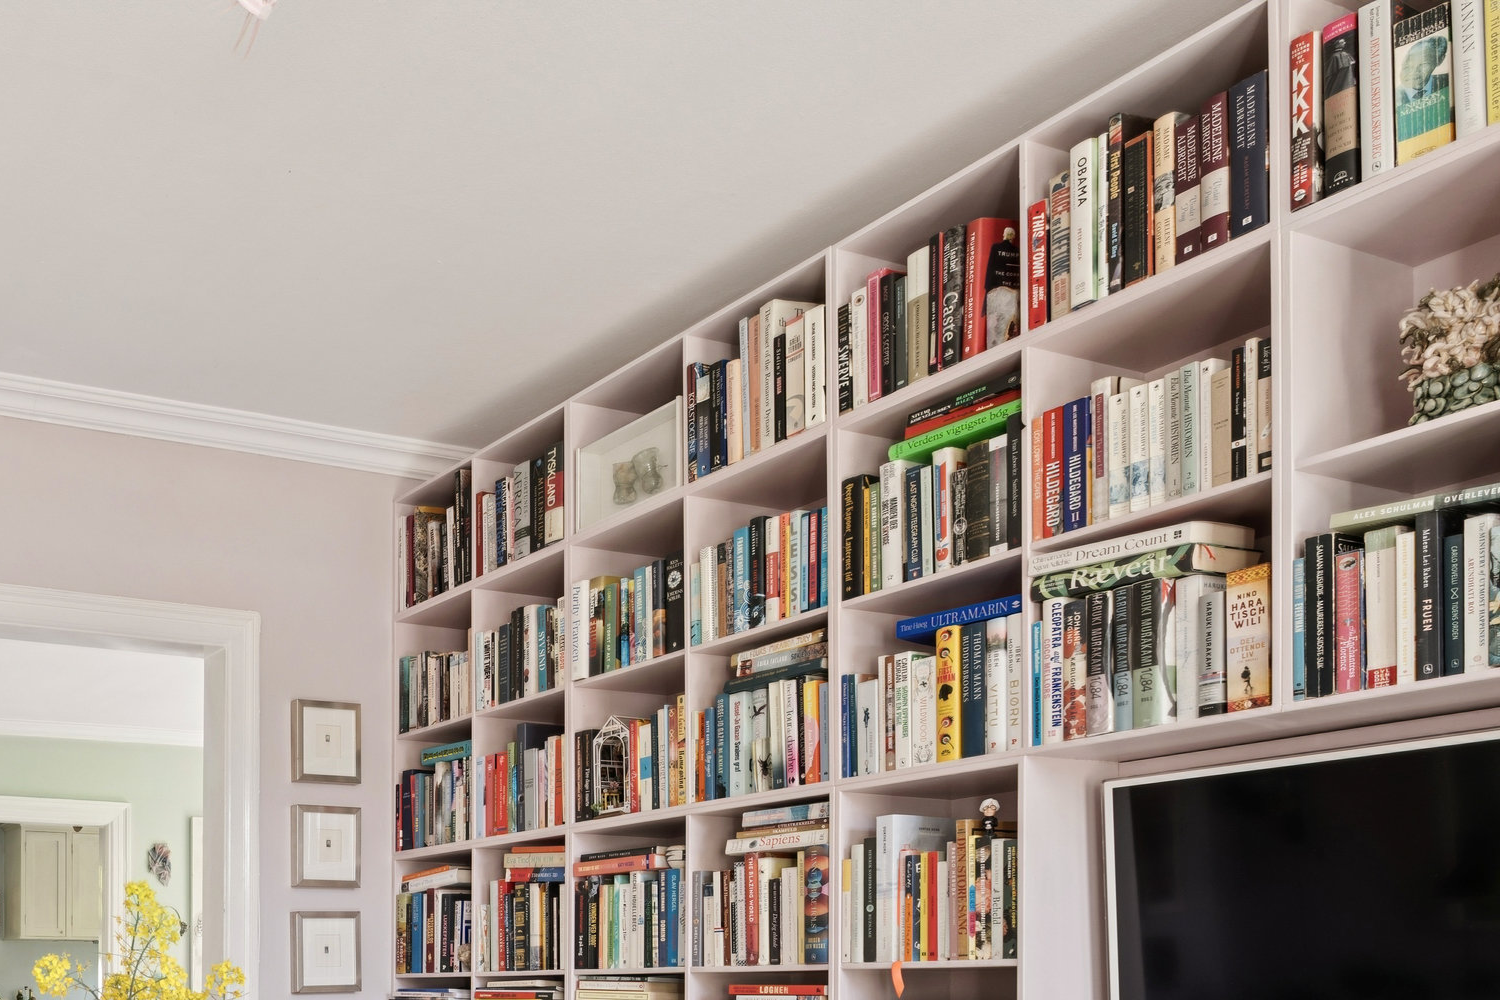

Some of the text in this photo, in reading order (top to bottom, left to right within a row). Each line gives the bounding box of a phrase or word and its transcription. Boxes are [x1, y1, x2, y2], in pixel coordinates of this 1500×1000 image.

[1203, 113, 1211, 163] ALBRIGHT
[1212, 101, 1222, 163] MADELEINE
[1237, 95, 1245, 150] ALBRIGHT
[1247, 84, 1256, 149] MADELEINE
[1178, 135, 1187, 183] ALBRIGHT
[1187, 124, 1196, 182] MADELEINE
[1077, 157, 1088, 208] OBAMA
[950, 248, 958, 273] Isabel
[968, 232, 976, 284] TRUMPOCRACY
[1032, 212, 1045, 278] THIS TOWN
[942, 291, 958, 344] Caste
[839, 344, 849, 388] SWERVE
[907, 430, 945, 450] Verdens
[946, 416, 988, 439] vigtigste
[514, 471, 524, 528] AFRICA
[547, 447, 557, 506] TYSKLAND
[1046, 462, 1060, 528] HILDEGARD
[1069, 454, 1082, 511] HILDEGARD
[1353, 499, 1435, 521] ALEX SCHULMAN
[1075, 533, 1168, 562] Dream Count
[1068, 552, 1173, 591] Ræveår
[1236, 589, 1258, 601] NINO
[1422, 528, 1432, 632] Malene Lei Raben FRUEN
[930, 600, 1009, 628] ULTRAMARIN
[1141, 582, 1152, 616] HARUKI
[1229, 606, 1266, 622] TISCH
[1231, 598, 1263, 613] HARA
[1451, 601, 1459, 621] TIDENS
[571, 586, 581, 663] Purity Franzen
[1051, 602, 1062, 649] CLEOPATRA
[1141, 618, 1152, 666] MURAKAMI
[1234, 616, 1262, 631] WILI
[1451, 621, 1459, 641] ORDEN
[962, 635, 970, 702] BUDDENBROOKS
[973, 632, 982, 701] THOMAS MANN
[1229, 642, 1266, 655] OTTENDE
[988, 684, 998, 727] VITTU
[1010, 679, 1020, 726] BJØRN
[1051, 667, 1062, 728] FRANKENSTEIN
[758, 834, 801, 848] Sapiens
[957, 837, 968, 935] DEN STORE SANG
[992, 897, 1002, 925] Beheld
[759, 986, 789, 994] LØGNEN
